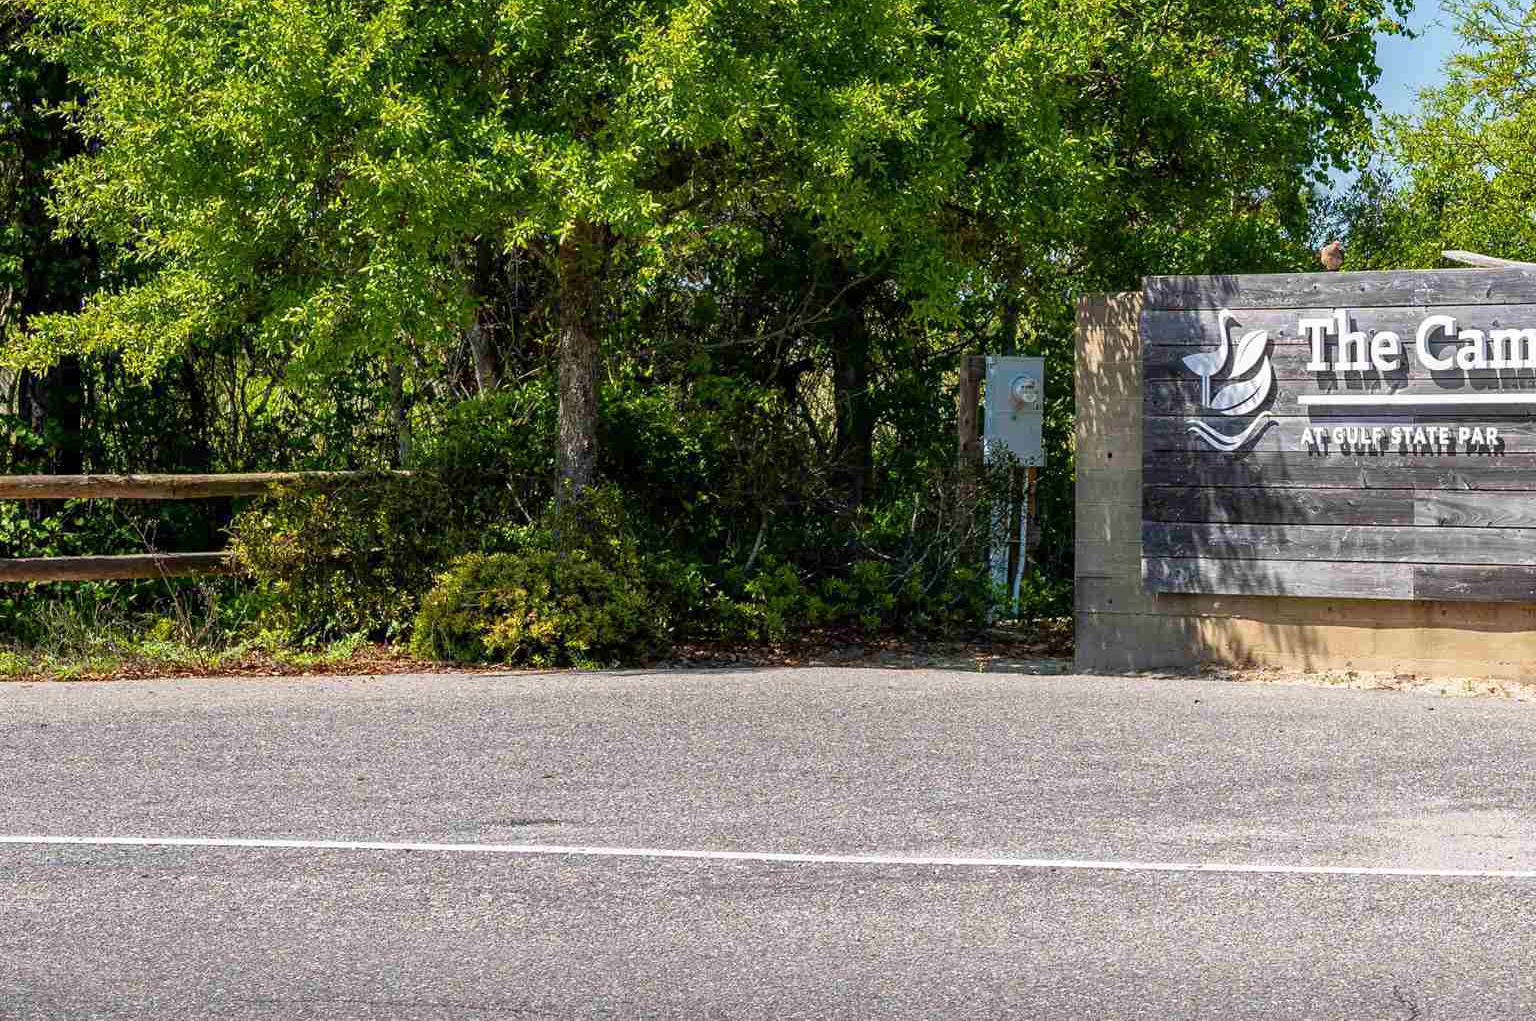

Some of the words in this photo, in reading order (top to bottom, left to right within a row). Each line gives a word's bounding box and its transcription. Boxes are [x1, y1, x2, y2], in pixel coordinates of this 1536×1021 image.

[1298, 308, 1401, 371] The
[1300, 426, 1325, 445] AT
[1332, 426, 1383, 445] GULF
[1390, 426, 1450, 445] STATE
[1458, 426, 1501, 446] PAR
